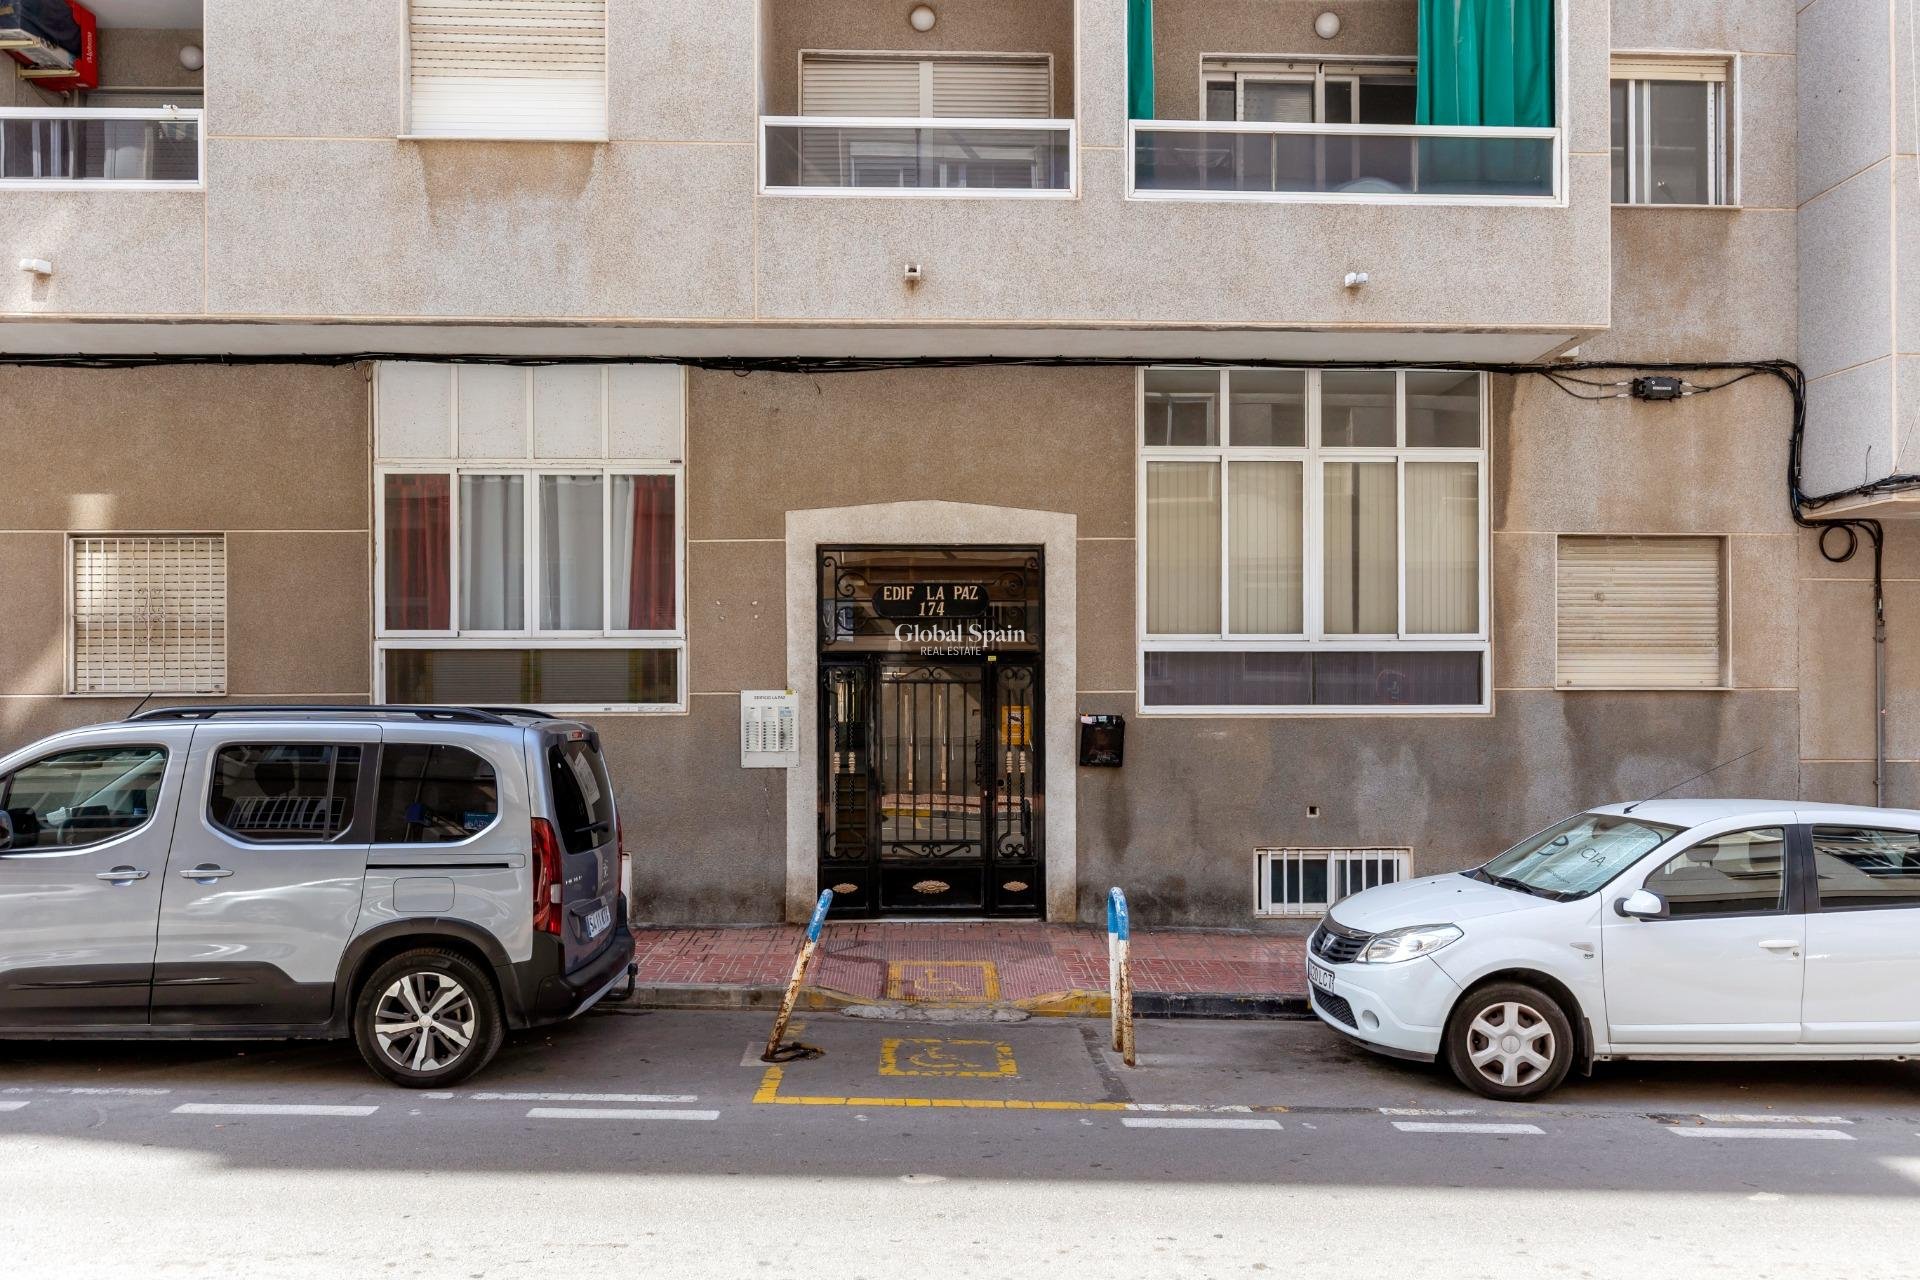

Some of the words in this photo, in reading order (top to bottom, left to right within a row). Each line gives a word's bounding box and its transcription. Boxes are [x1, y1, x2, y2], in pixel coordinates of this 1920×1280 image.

[883, 586, 915, 600] EDIF
[926, 586, 945, 600] LA
[953, 586, 979, 600] PAZ
[918, 602, 945, 616] 174
